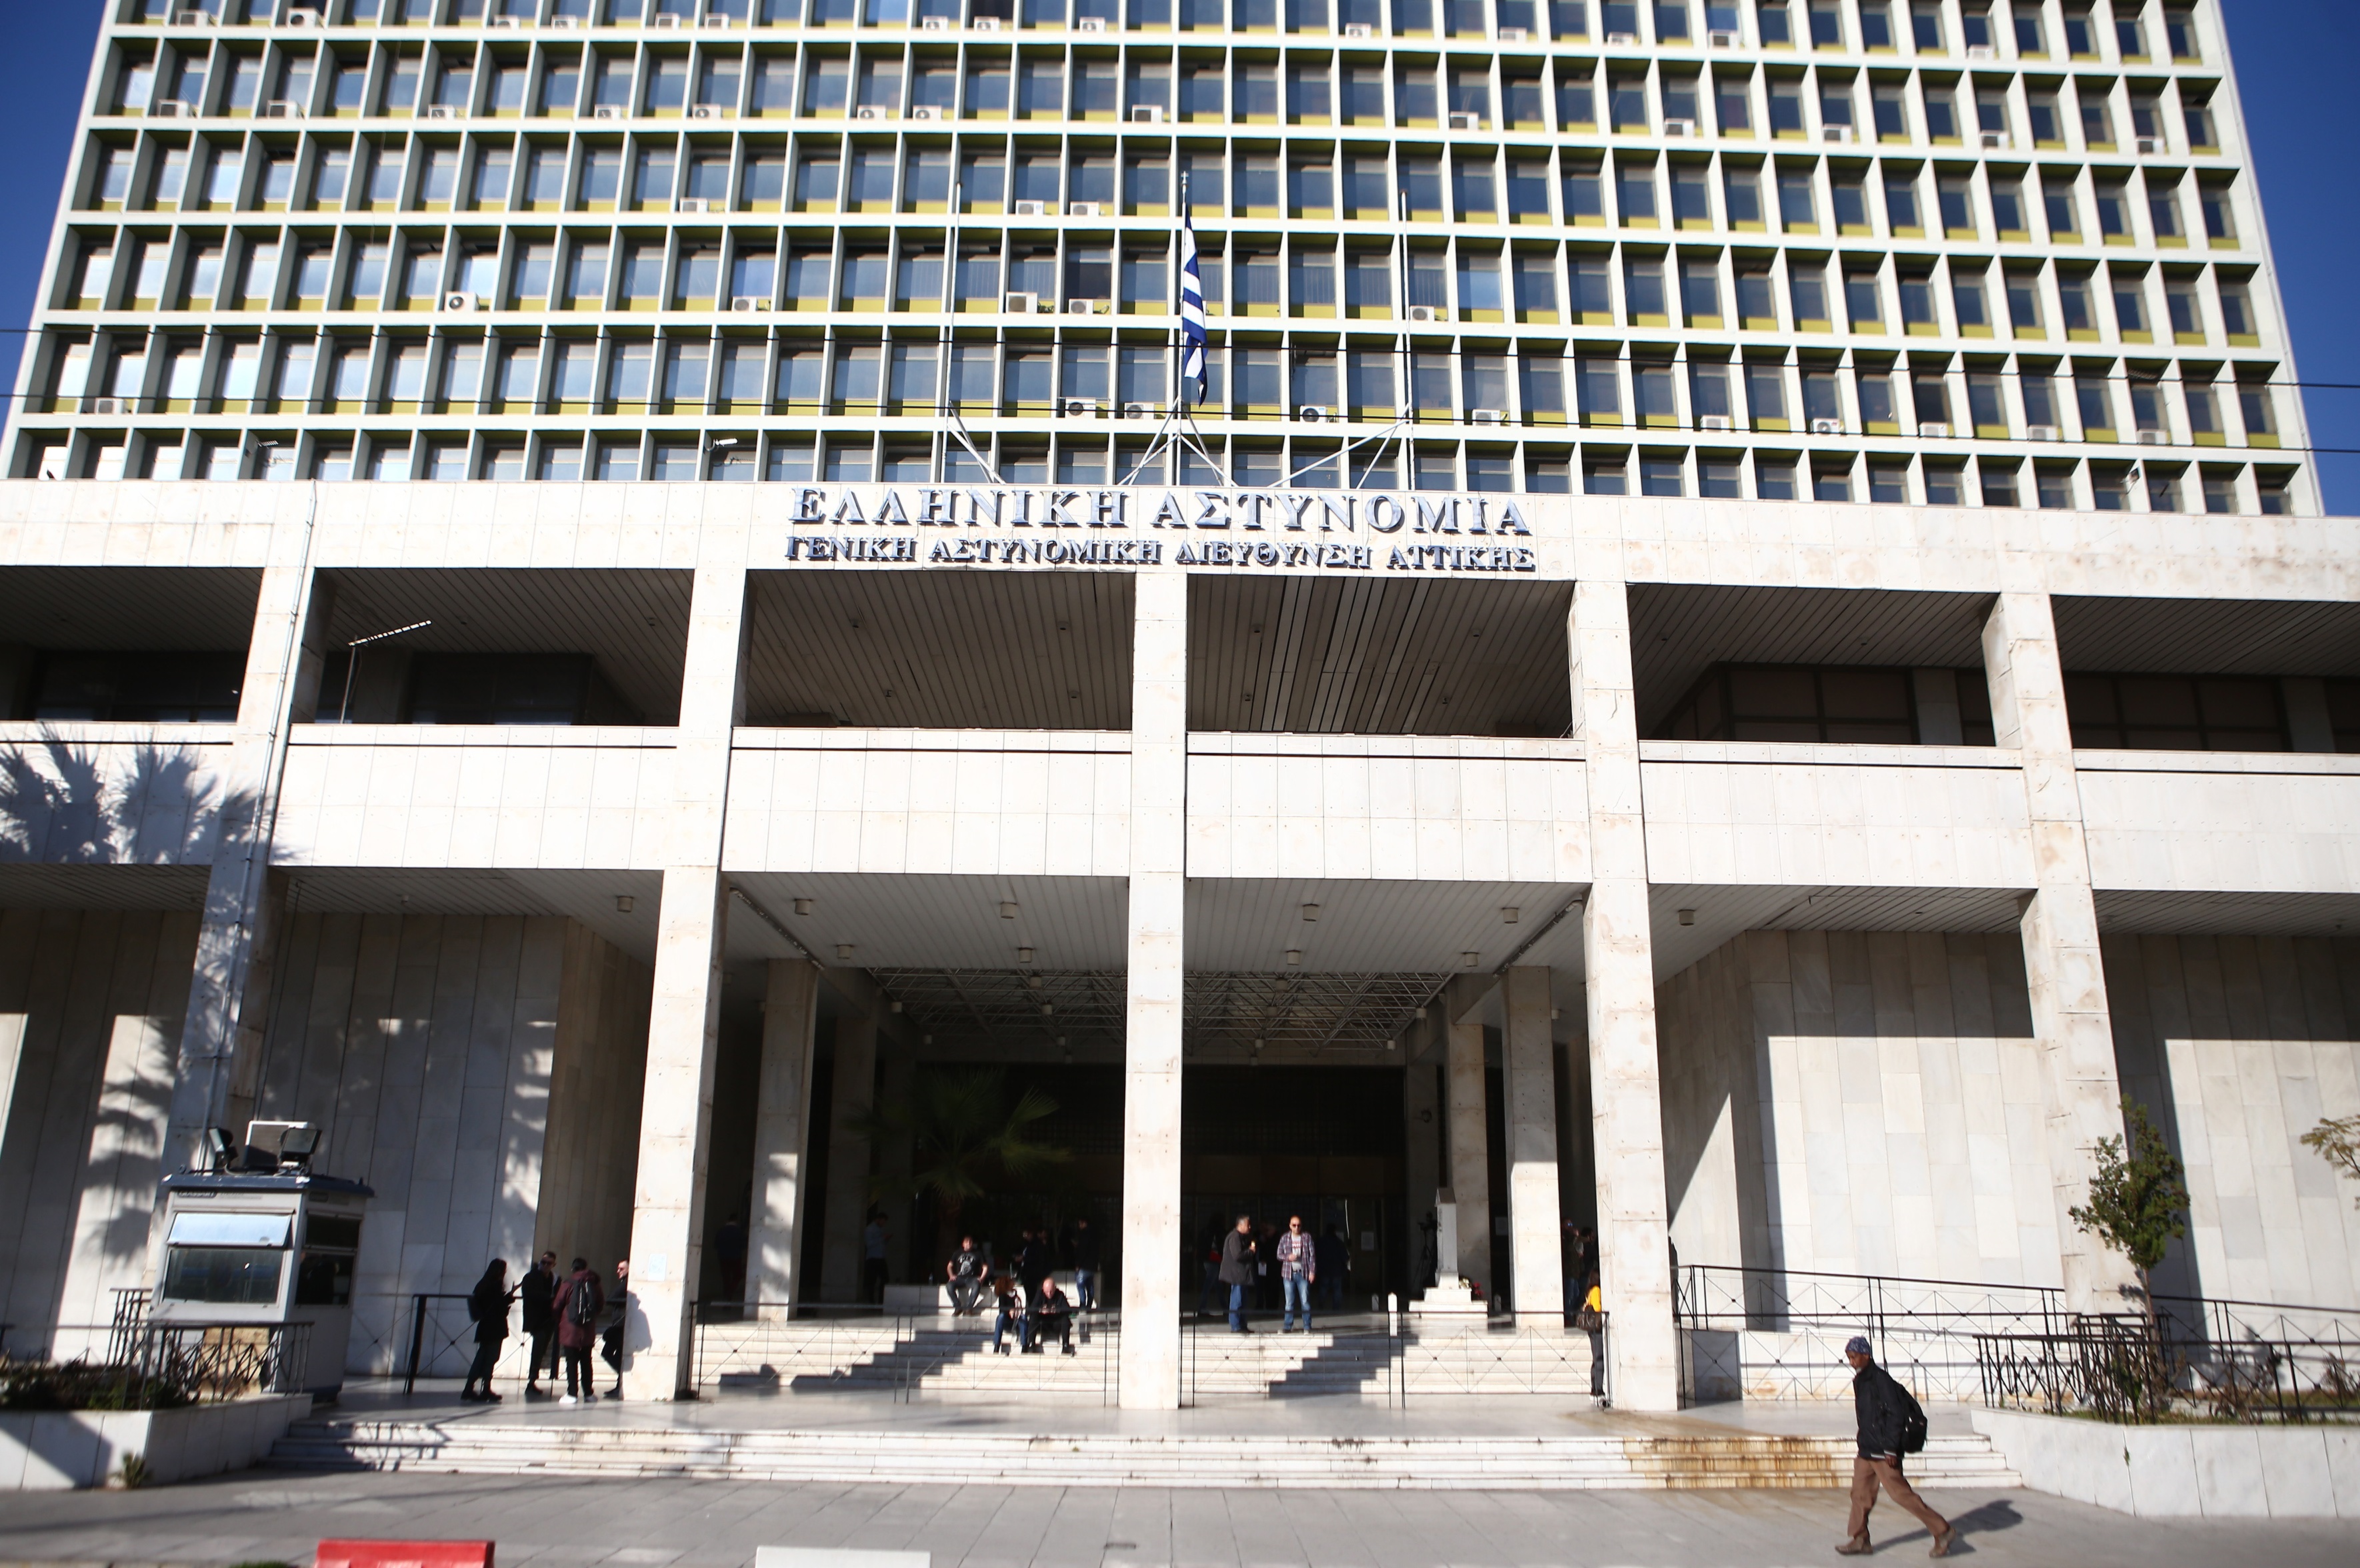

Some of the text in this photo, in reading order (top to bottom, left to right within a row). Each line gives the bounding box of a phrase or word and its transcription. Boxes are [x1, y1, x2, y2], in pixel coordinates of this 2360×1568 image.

[788, 487, 1529, 533] ΕΛΛΗΝΙΚΗ ΑΣΤΥΝΟΜΙΑ
[784, 535, 1534, 568] ΓΕΝΙΚΗ ΑΣΤΥΝΟΜΙΚΗ ΔΙΕΥΘΥΝΣΗ ΑΤΤΙΚΗΣ
